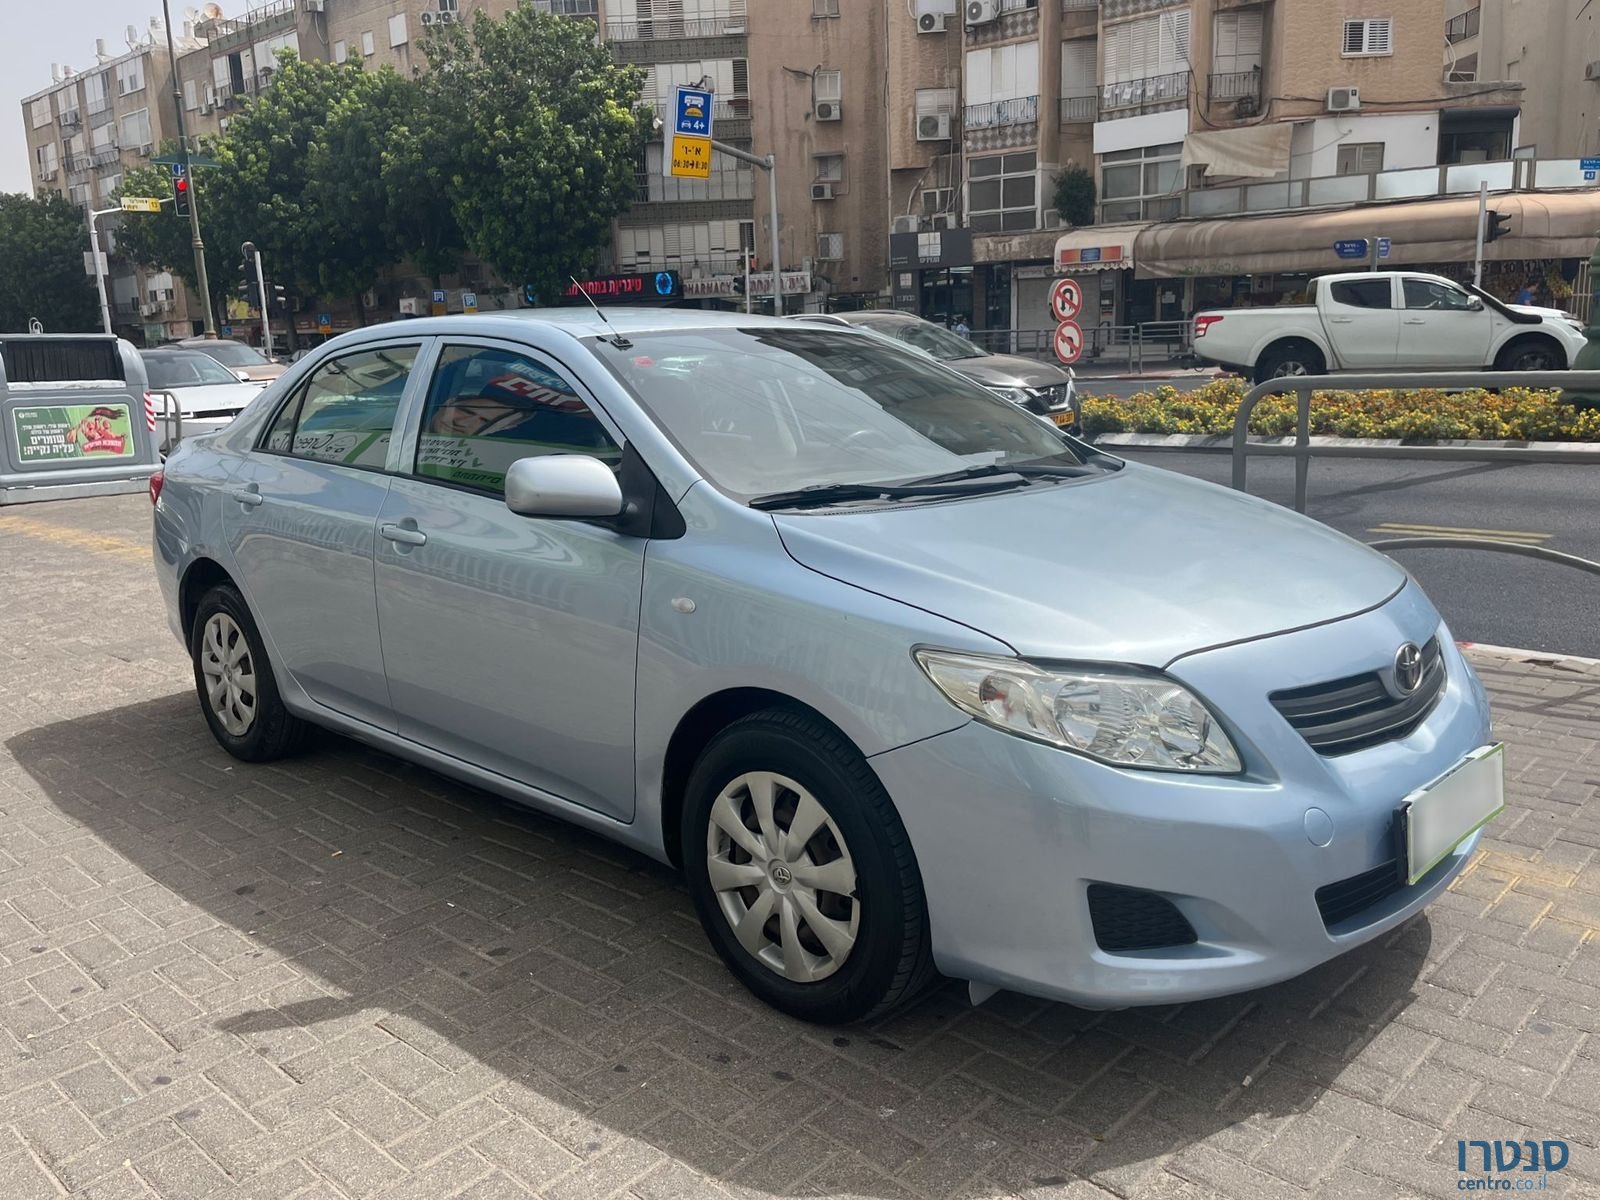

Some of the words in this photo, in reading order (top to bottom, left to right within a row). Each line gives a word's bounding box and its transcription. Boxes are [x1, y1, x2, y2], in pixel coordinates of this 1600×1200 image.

[30, 434, 65, 445] שומרים
[24, 445, 50, 456] נקייה!
[53, 443, 74, 454] עליה
